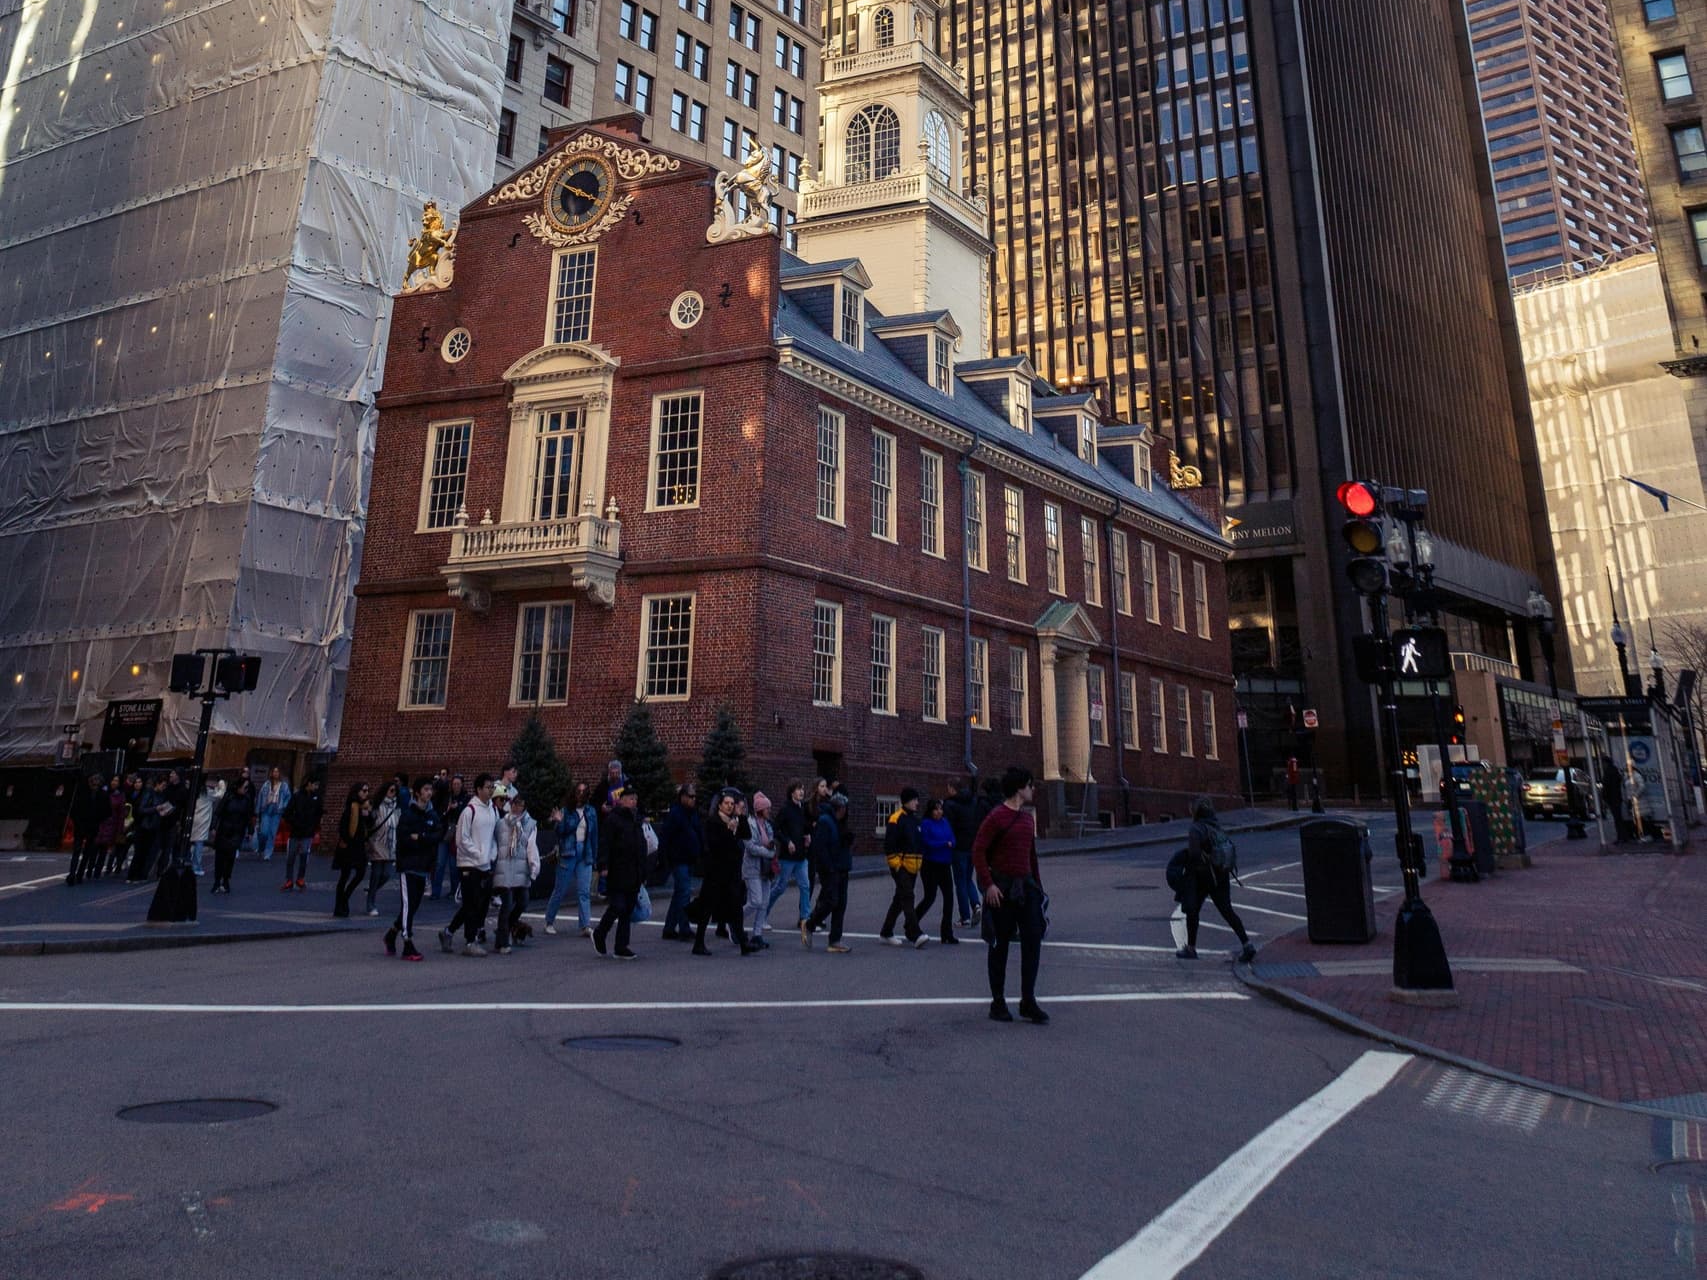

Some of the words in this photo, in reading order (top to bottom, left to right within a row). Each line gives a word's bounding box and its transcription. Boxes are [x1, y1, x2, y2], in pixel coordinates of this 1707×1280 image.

[1231, 529, 1249, 540] BNY
[1252, 526, 1292, 538] MELLON
[119, 703, 137, 713] STONE
